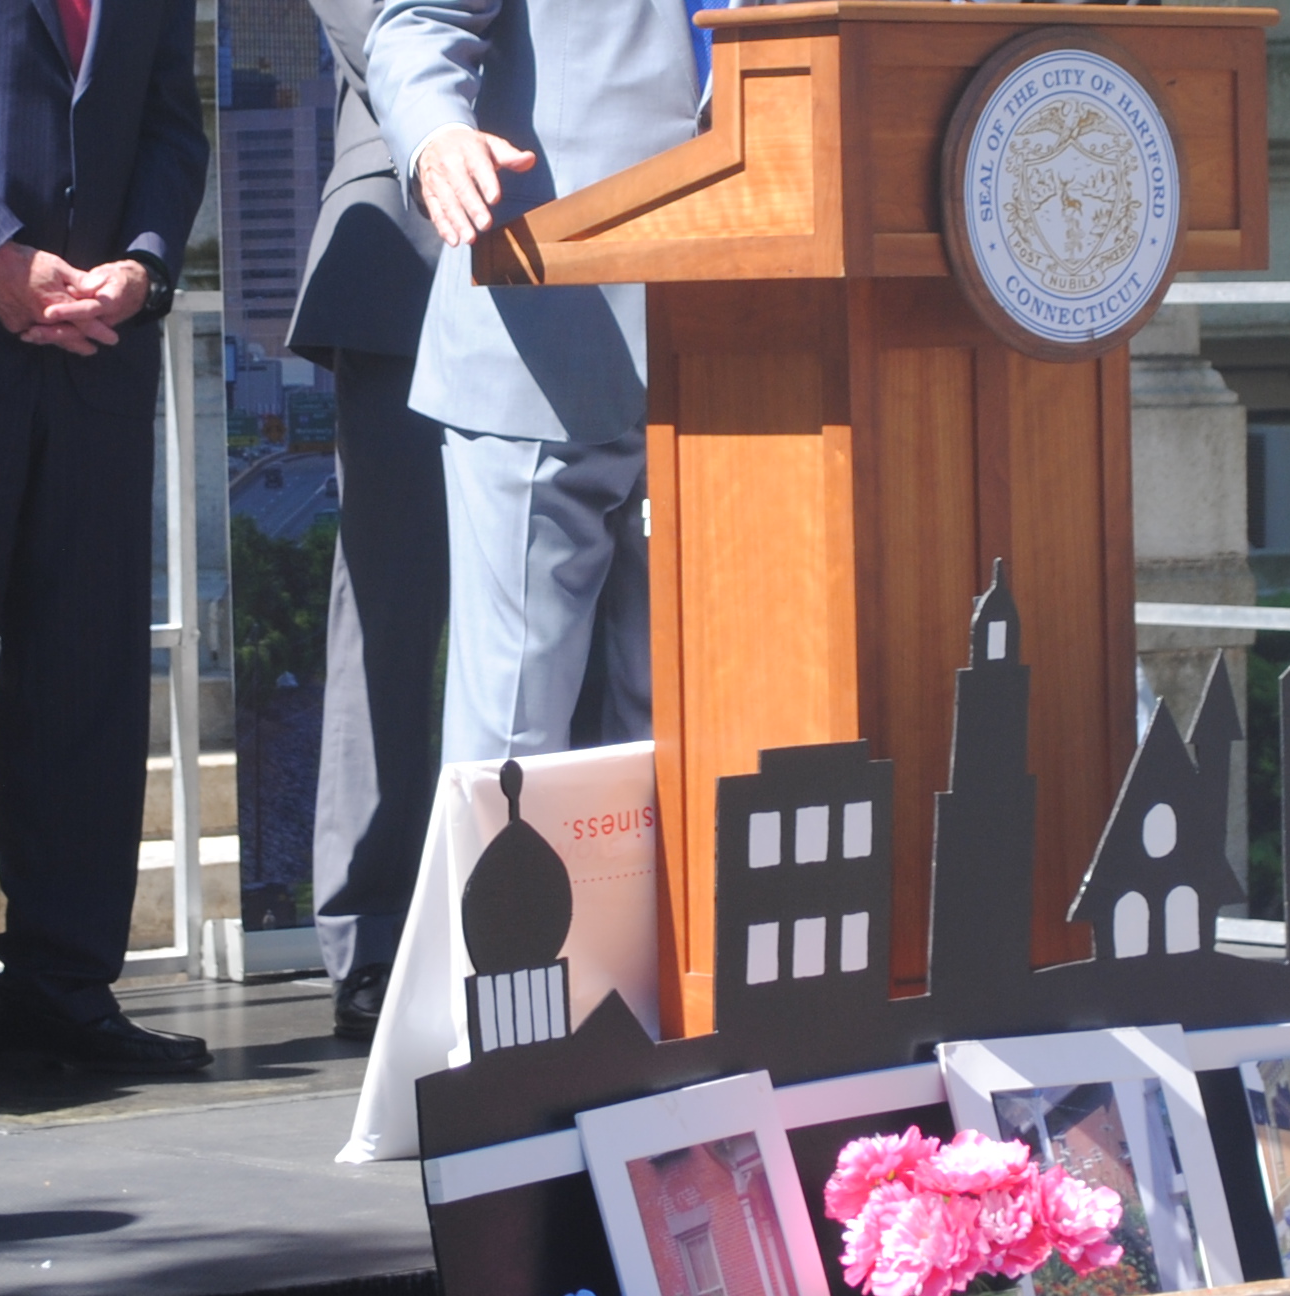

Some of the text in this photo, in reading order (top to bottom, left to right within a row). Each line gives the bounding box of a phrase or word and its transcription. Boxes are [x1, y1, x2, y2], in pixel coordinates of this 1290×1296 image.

[980, 69, 1166, 222] SEAL OF THE CITY OF HARTFORD
[1013, 240, 1043, 266] POST
[1049, 275, 1098, 290] NUBILA
[1006, 272, 1143, 326] CONNECTICUT
[564, 806, 653, 840] siness.
